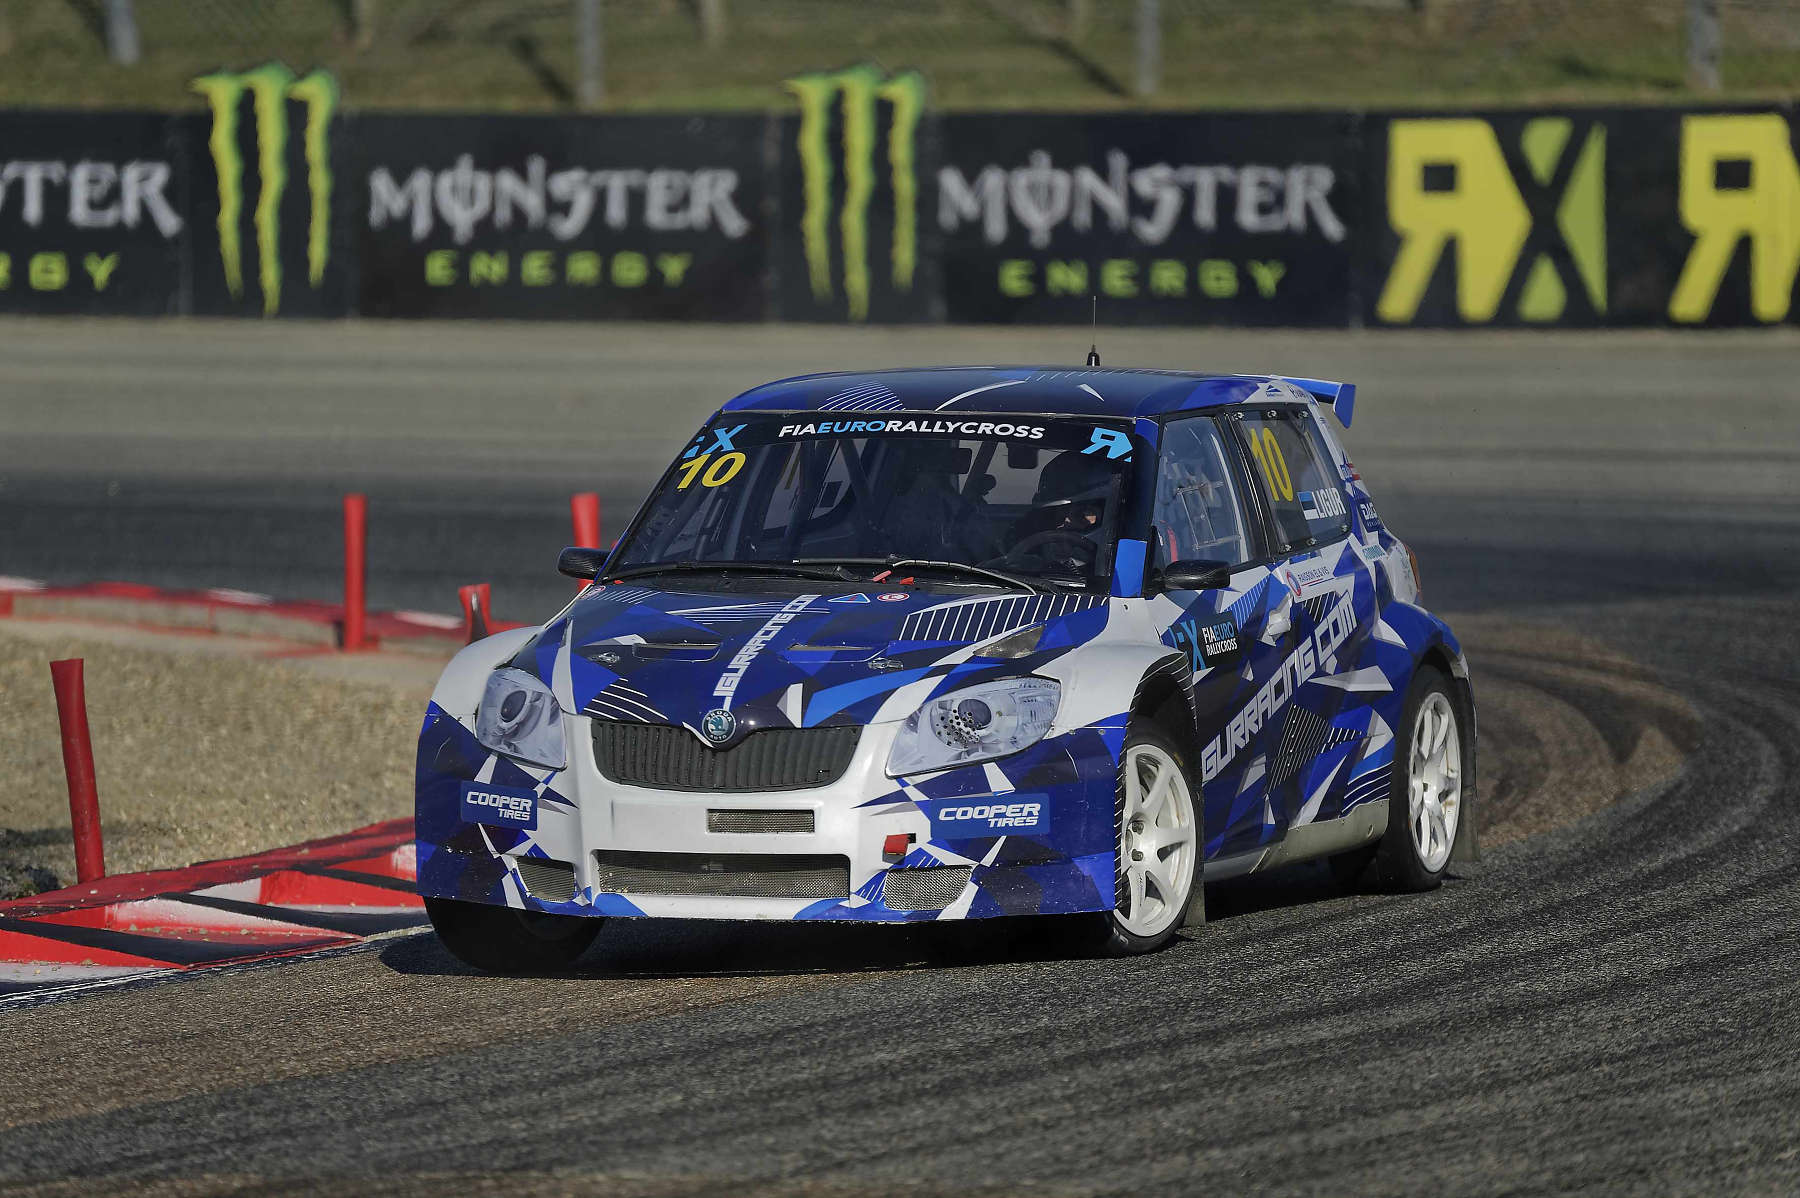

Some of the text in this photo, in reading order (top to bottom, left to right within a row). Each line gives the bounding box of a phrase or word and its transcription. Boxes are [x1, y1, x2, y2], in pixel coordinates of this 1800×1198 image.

[0, 159, 184, 238] TER
[368, 153, 750, 245] MONSTER
[936, 149, 1346, 249] MONSTER
[424, 250, 694, 287] ENERGY
[998, 258, 1286, 299] ENERGY
[778, 420, 1046, 440] FIAEURORALLYCROSS
[676, 451, 747, 489] 10
[1250, 427, 1294, 502] 10
[1311, 487, 1347, 519] LIGUR
[1201, 621, 1236, 644] FIAEURO
[1205, 638, 1238, 657] RALLYCROSS
[466, 791, 532, 812] COOPER
[497, 808, 531, 821] TIRES
[939, 803, 1041, 821] COOPER
[988, 816, 1039, 828] TIRES
